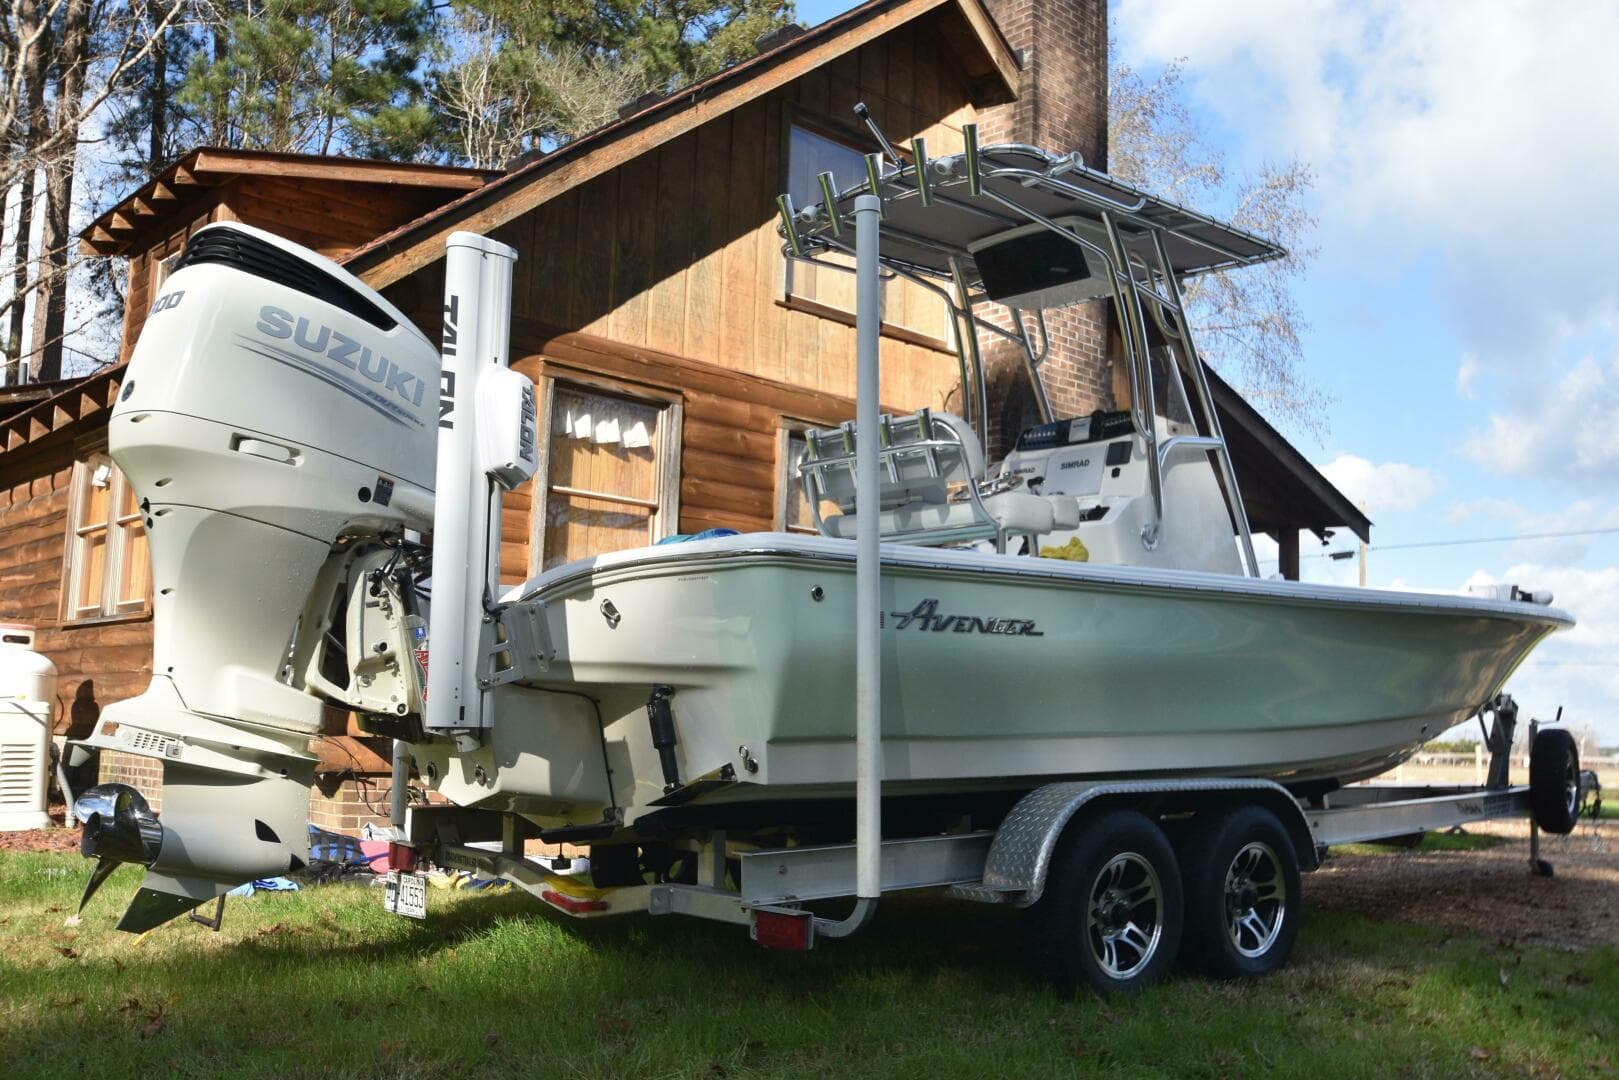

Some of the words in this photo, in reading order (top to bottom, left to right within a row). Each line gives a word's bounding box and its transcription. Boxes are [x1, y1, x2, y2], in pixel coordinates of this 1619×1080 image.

[256, 305, 425, 408] SUZUKI
[438, 295, 459, 430] TALON
[520, 384, 536, 464] TALON
[1060, 459, 1090, 470] SIMRAD
